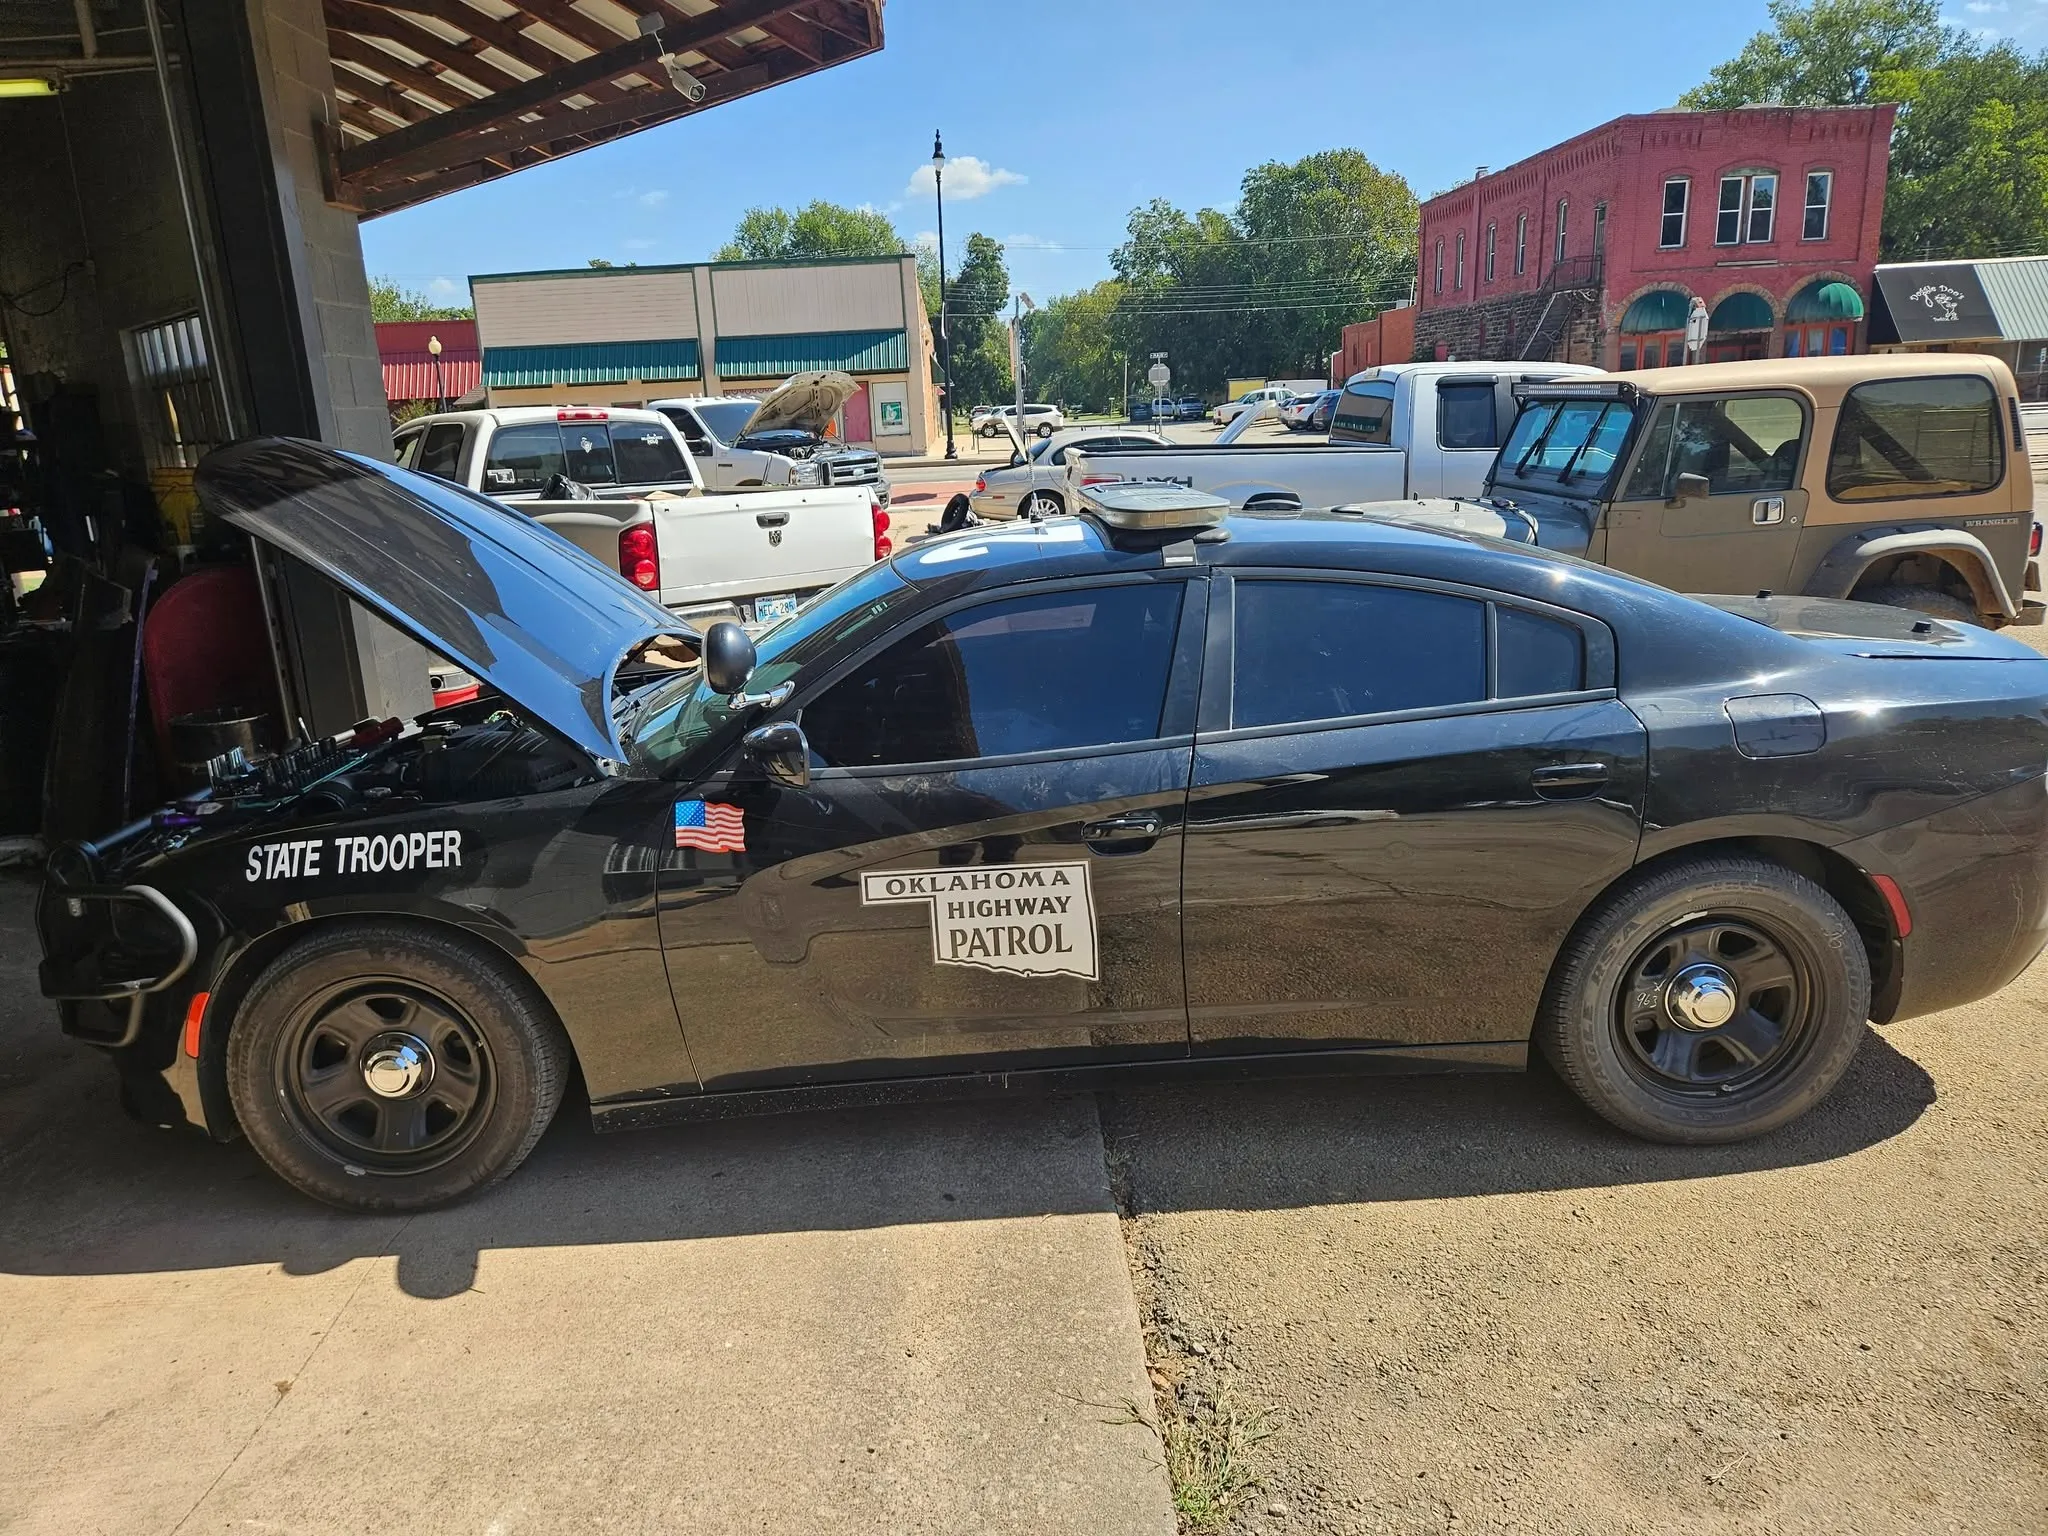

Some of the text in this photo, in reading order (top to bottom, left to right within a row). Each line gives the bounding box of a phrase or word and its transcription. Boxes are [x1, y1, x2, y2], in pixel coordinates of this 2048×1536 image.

[1965, 517, 2019, 527] WRANGLER
[245, 830, 462, 882] STATE TROOPER
[885, 870, 1071, 896] OKLAHOMA
[947, 895, 1072, 920] HIGHWAY
[949, 923, 1073, 959] PATROL
[1636, 991, 1658, 1009] 963
